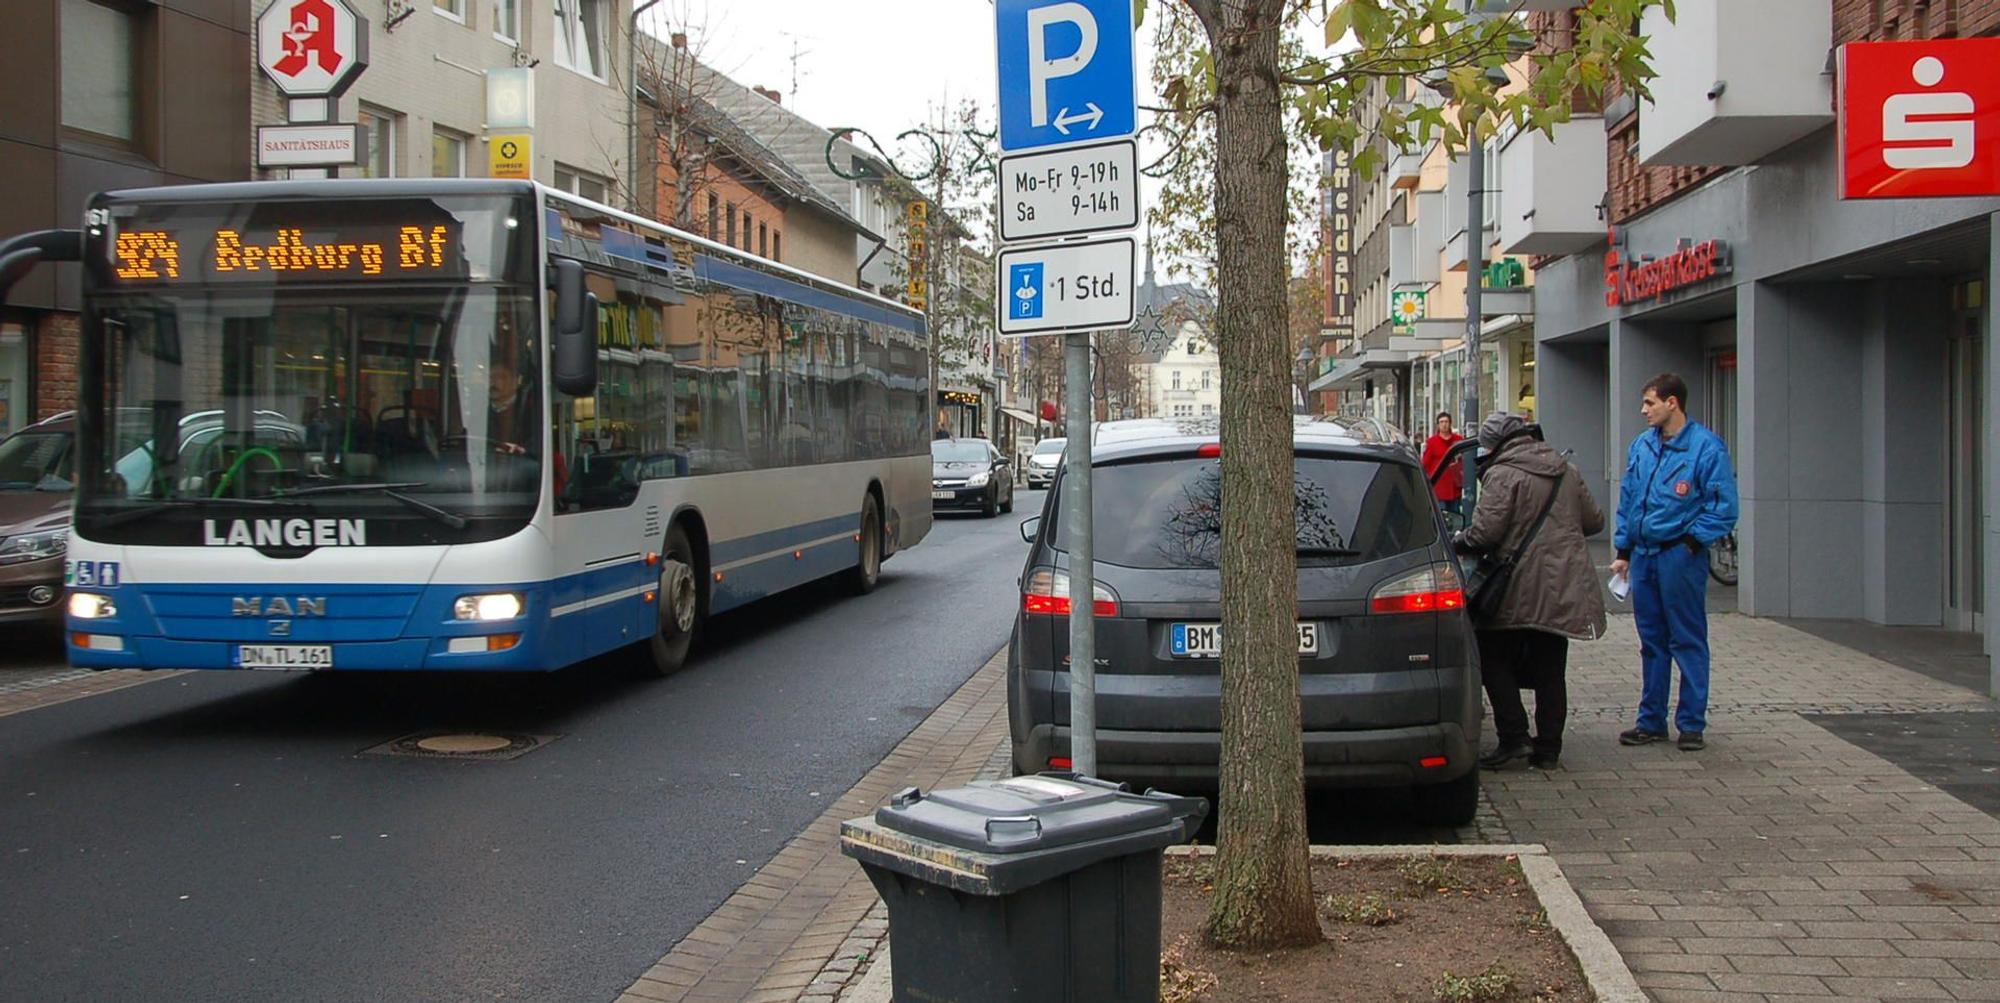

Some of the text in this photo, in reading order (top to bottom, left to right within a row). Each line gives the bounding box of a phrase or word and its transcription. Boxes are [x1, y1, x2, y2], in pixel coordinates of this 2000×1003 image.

[1027, 2, 1098, 128] P
[265, 139, 350, 151] SANITÄTSHAUS
[1016, 168, 1063, 193] Mo-Fr
[1017, 202, 1035, 222] Sa
[216, 228, 383, 274] Bedburg
[400, 226, 447, 268] Bf
[1057, 273, 1119, 301] 1 Std.
[204, 519, 366, 546] LANGEN
[232, 597, 327, 616] MAN
[1187, 626, 1314, 649] BM 5
[241, 648, 330, 664] DN TL 161
